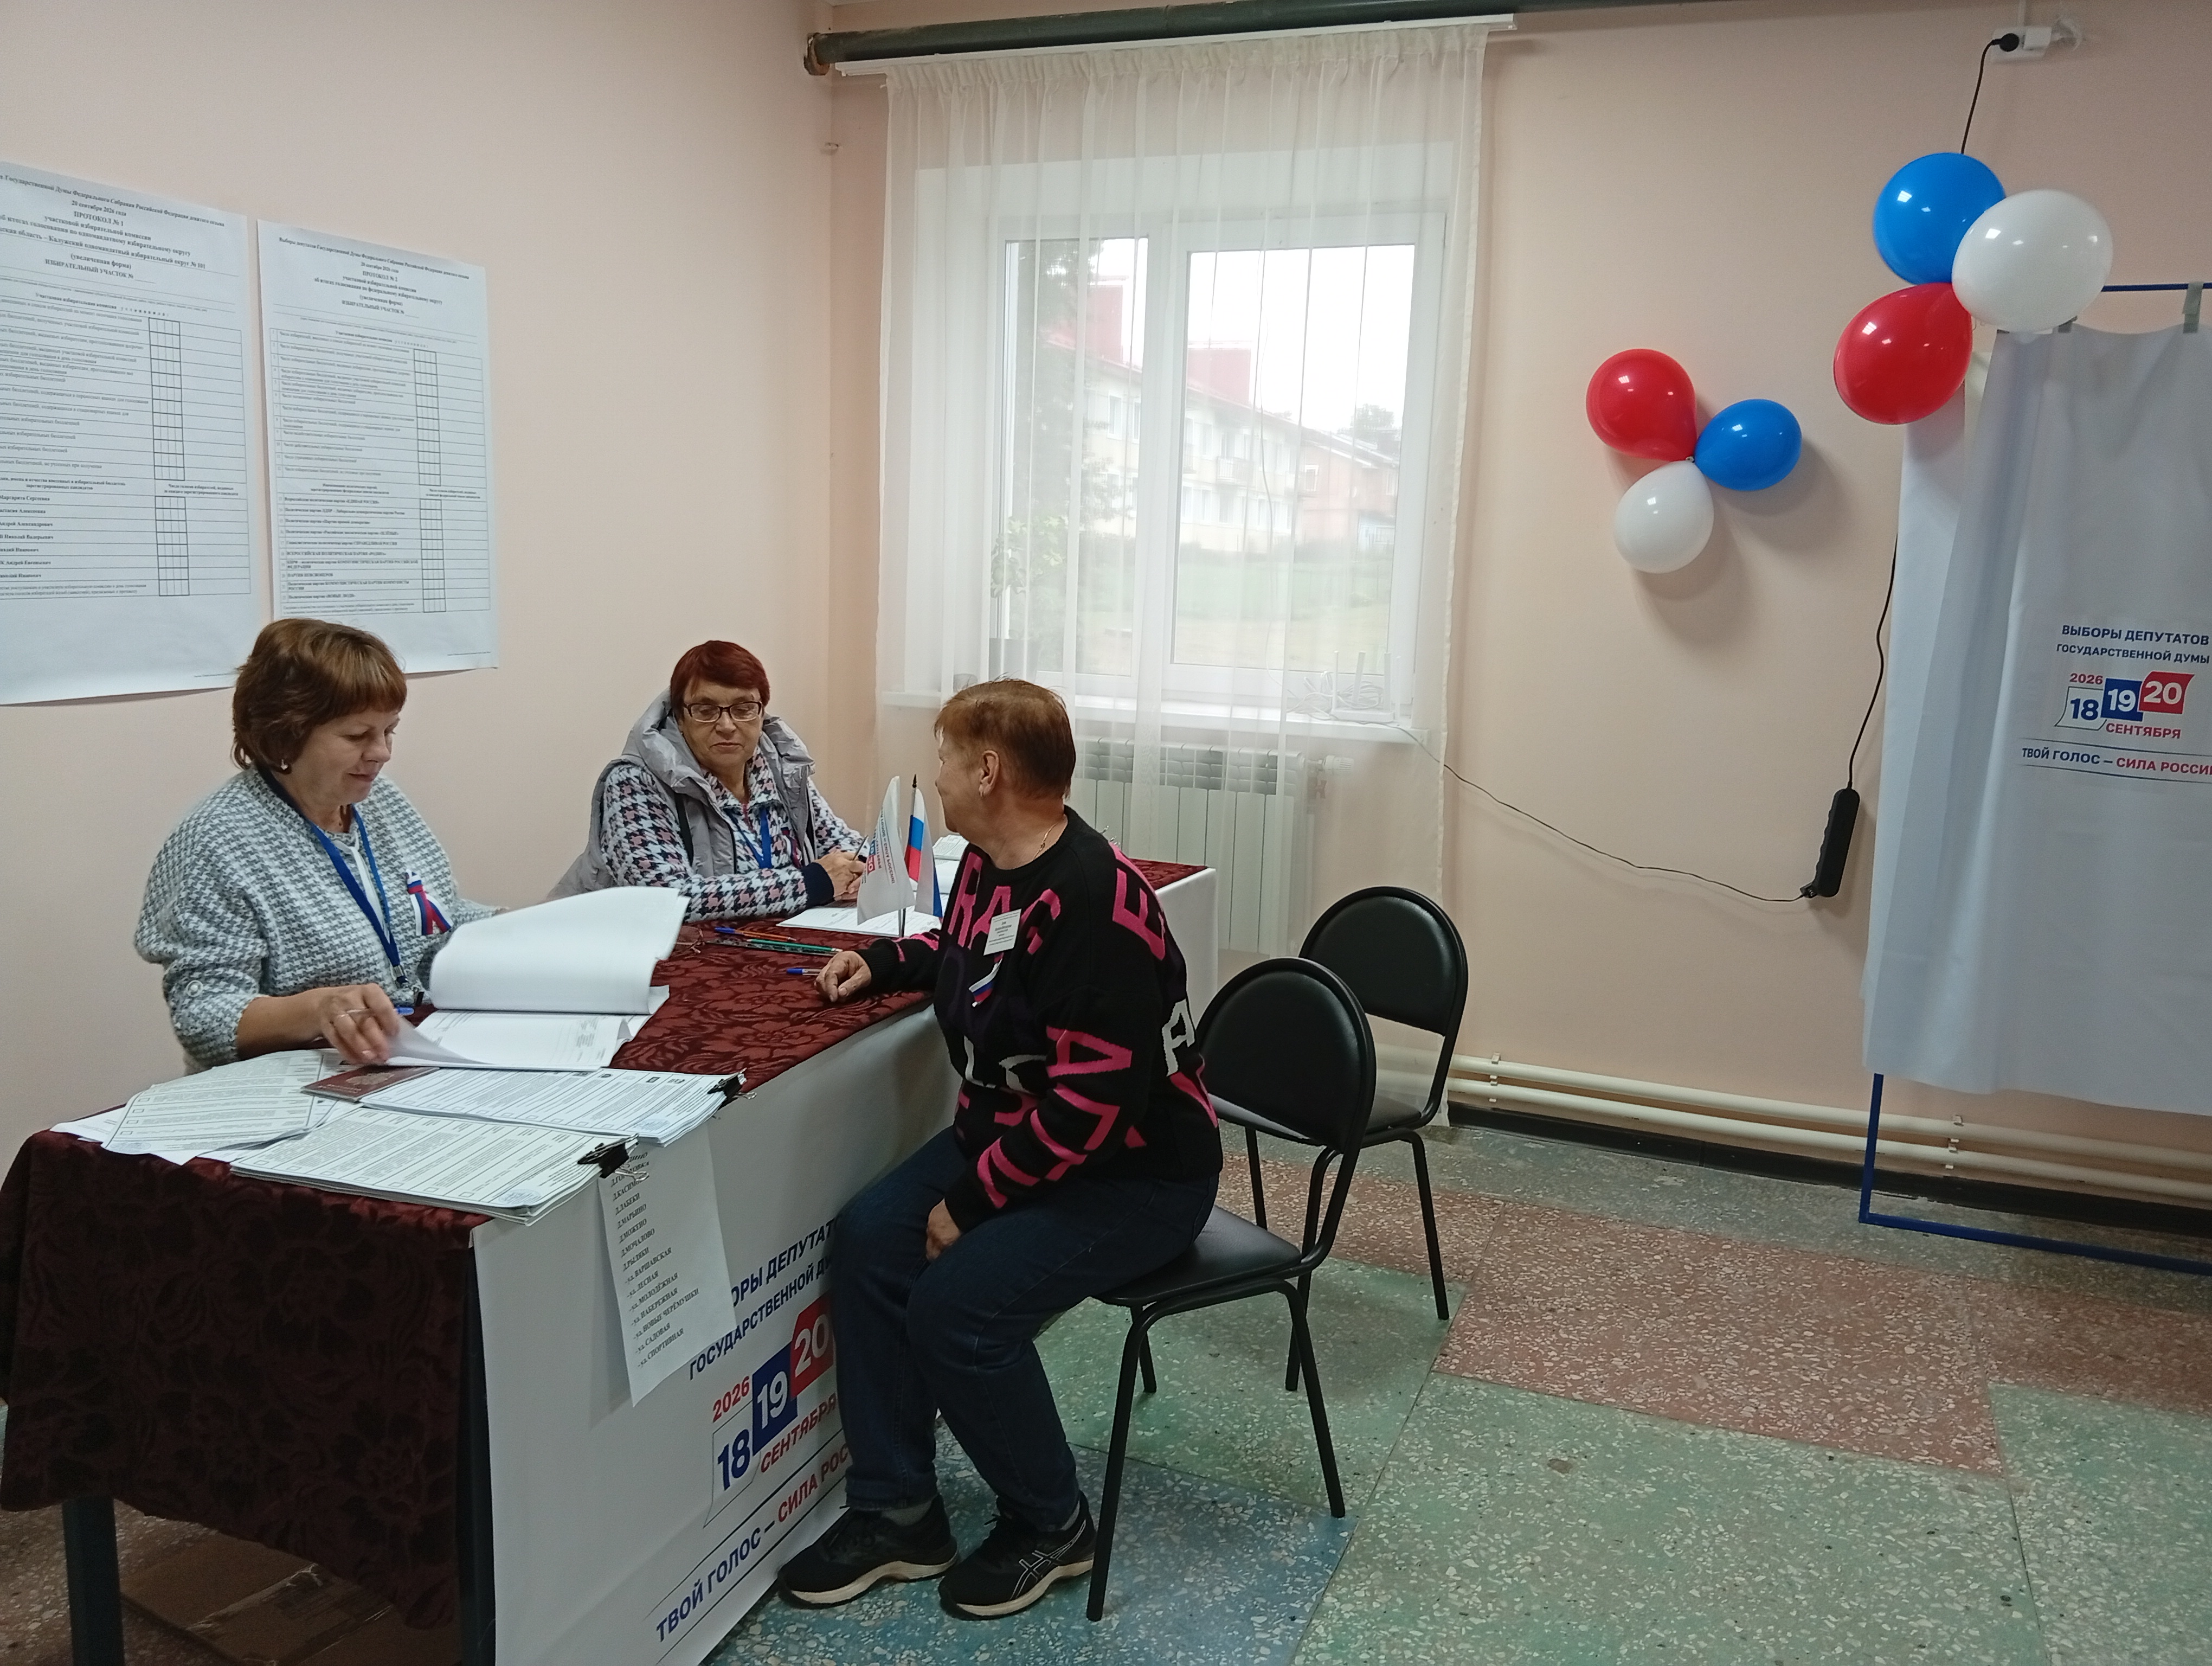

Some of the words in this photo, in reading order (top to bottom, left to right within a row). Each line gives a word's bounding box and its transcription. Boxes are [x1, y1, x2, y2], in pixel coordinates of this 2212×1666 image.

[44, 216, 79, 227] участковой
[80, 223, 124, 236] избирательной
[124, 232, 151, 241] комиссии
[74, 210, 112, 224] ПРОТОКОЛ
[18, 229, 43, 240] область
[48, 235, 83, 247] Калужский
[45, 259, 99, 273] ИЗБИРАТЕЛЬНЫЙ
[99, 268, 127, 278] УЧАСТОК
[70, 253, 111, 265] (увеличенная
[111, 260, 132, 270] форма)
[362, 271, 389, 280] ПРОТОКОЛ
[2062, 625, 2122, 639] ВЫБОРЫ
[2124, 630, 2209, 645] ДЕПУТАТОВ
[2056, 643, 2171, 662] ГОСУДАРСТВЕННОЙ
[2174, 653, 2210, 664] ДУМЫ
[2069, 673, 2103, 684] 2026
[2070, 699, 2099, 721] 18
[2107, 689, 2136, 712] 19
[2143, 681, 2182, 704] 20
[2106, 722, 2181, 739] СЕНТЯБРЯ
[2022, 747, 2049, 759] ТВОЙ
[2053, 750, 2100, 764] ГОЛОС
[2116, 758, 2156, 771] СИЛА
[634, 1247, 672, 1277] ВАРШАВСКАЯ
[731, 1266, 762, 1308] ОРЫ
[766, 1218, 835, 1284] ДЕПУТАТ
[636, 1270, 659, 1291] ЛЕСНАЯ
[640, 1287, 678, 1319] НАБЕРЕЖНАЯ
[642, 1313, 663, 1332] НОВЫЕ
[645, 1322, 671, 1346] САДОВАЯ
[689, 1263, 814, 1381] ГОСУДАРСТВЕННОЙ
[647, 1328, 684, 1360] СПОРТИВНАЯ
[713, 1375, 750, 1423] 2026
[717, 1429, 750, 1491] 18
[757, 1371, 788, 1428] 19
[795, 1313, 829, 1377] 20
[761, 1392, 837, 1473] СЕНТЯБРЯ
[656, 1579, 703, 1642] ТВОЙ
[708, 1527, 761, 1594] ГОЛОС
[777, 1473, 817, 1523] СИЛА
[821, 1443, 848, 1483] РОС
